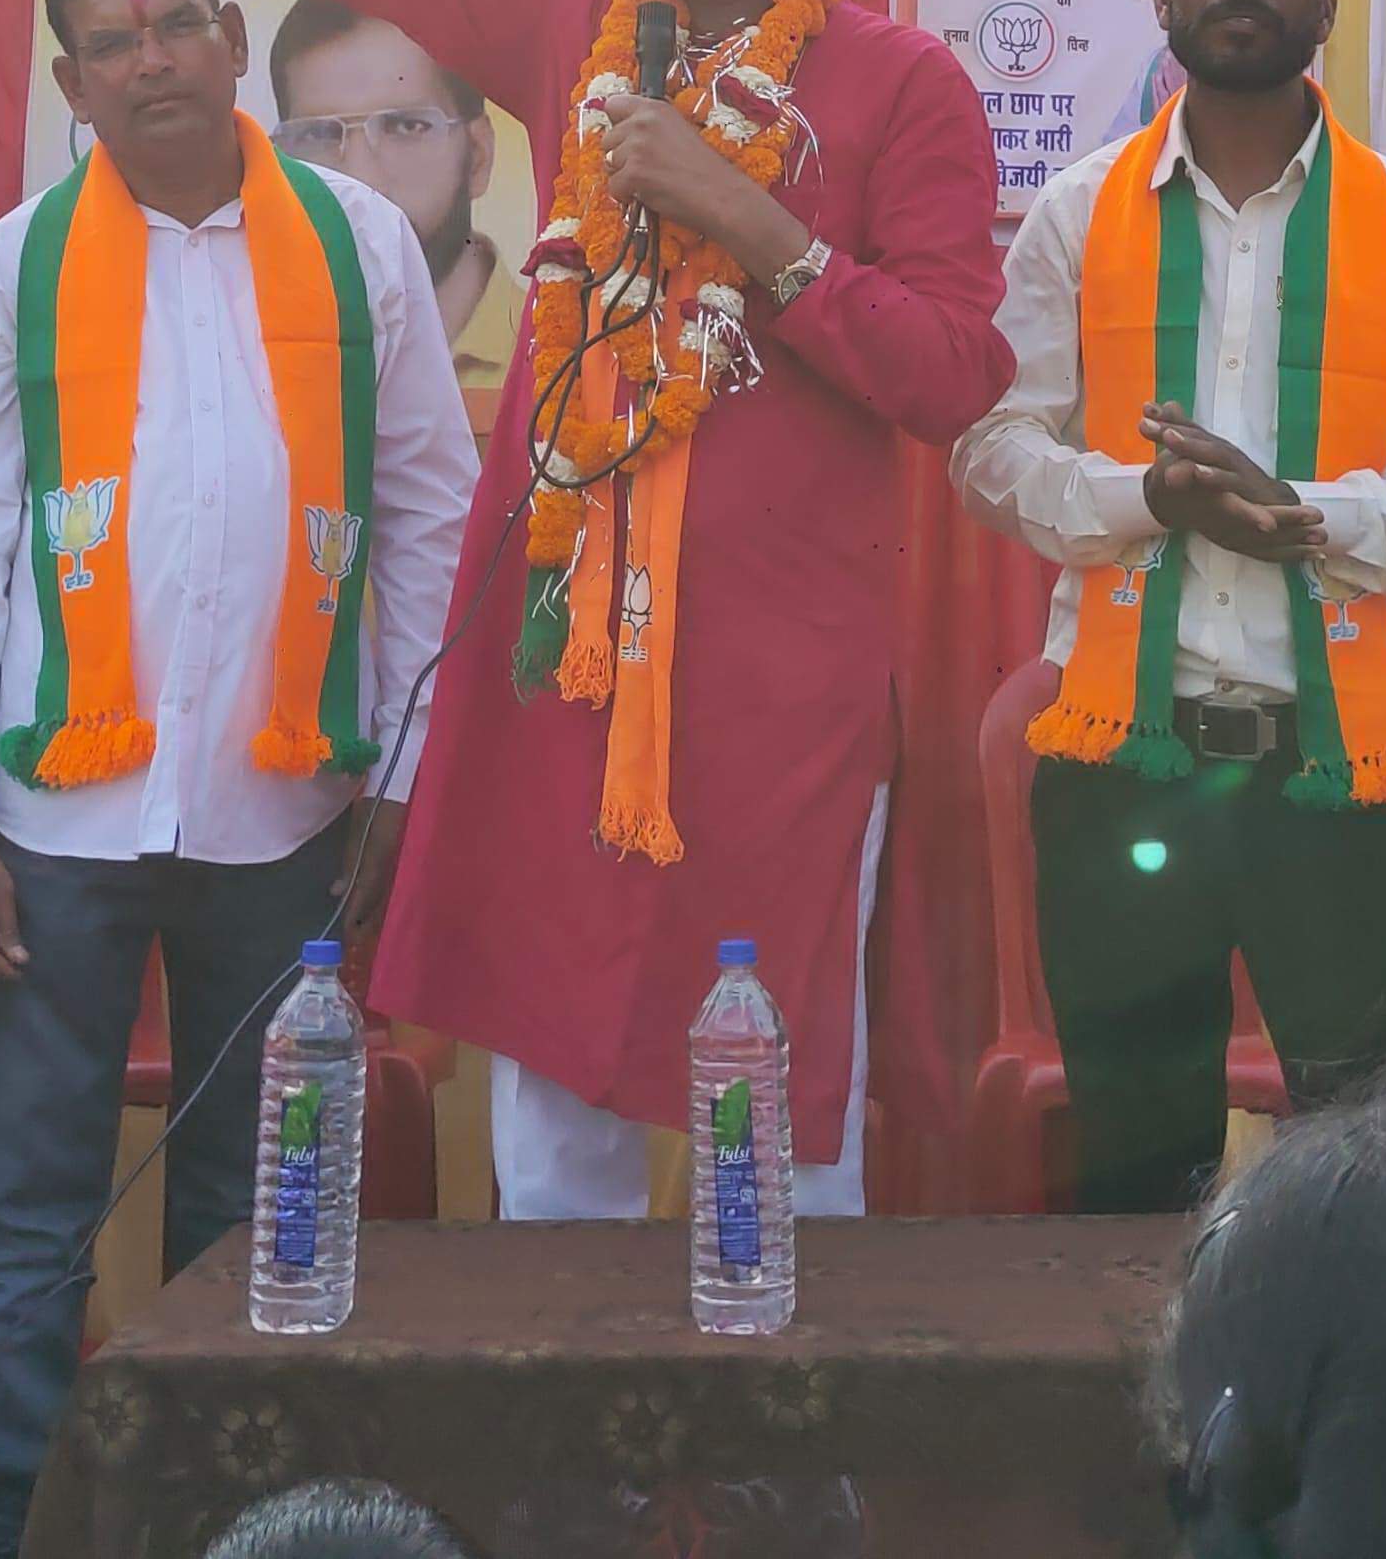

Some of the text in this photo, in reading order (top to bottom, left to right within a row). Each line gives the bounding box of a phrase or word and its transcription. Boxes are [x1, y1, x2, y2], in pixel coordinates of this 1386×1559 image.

[1010, 93, 1045, 116] छाप
[1051, 95, 1075, 117] पर
[1036, 124, 1072, 152] भारी
